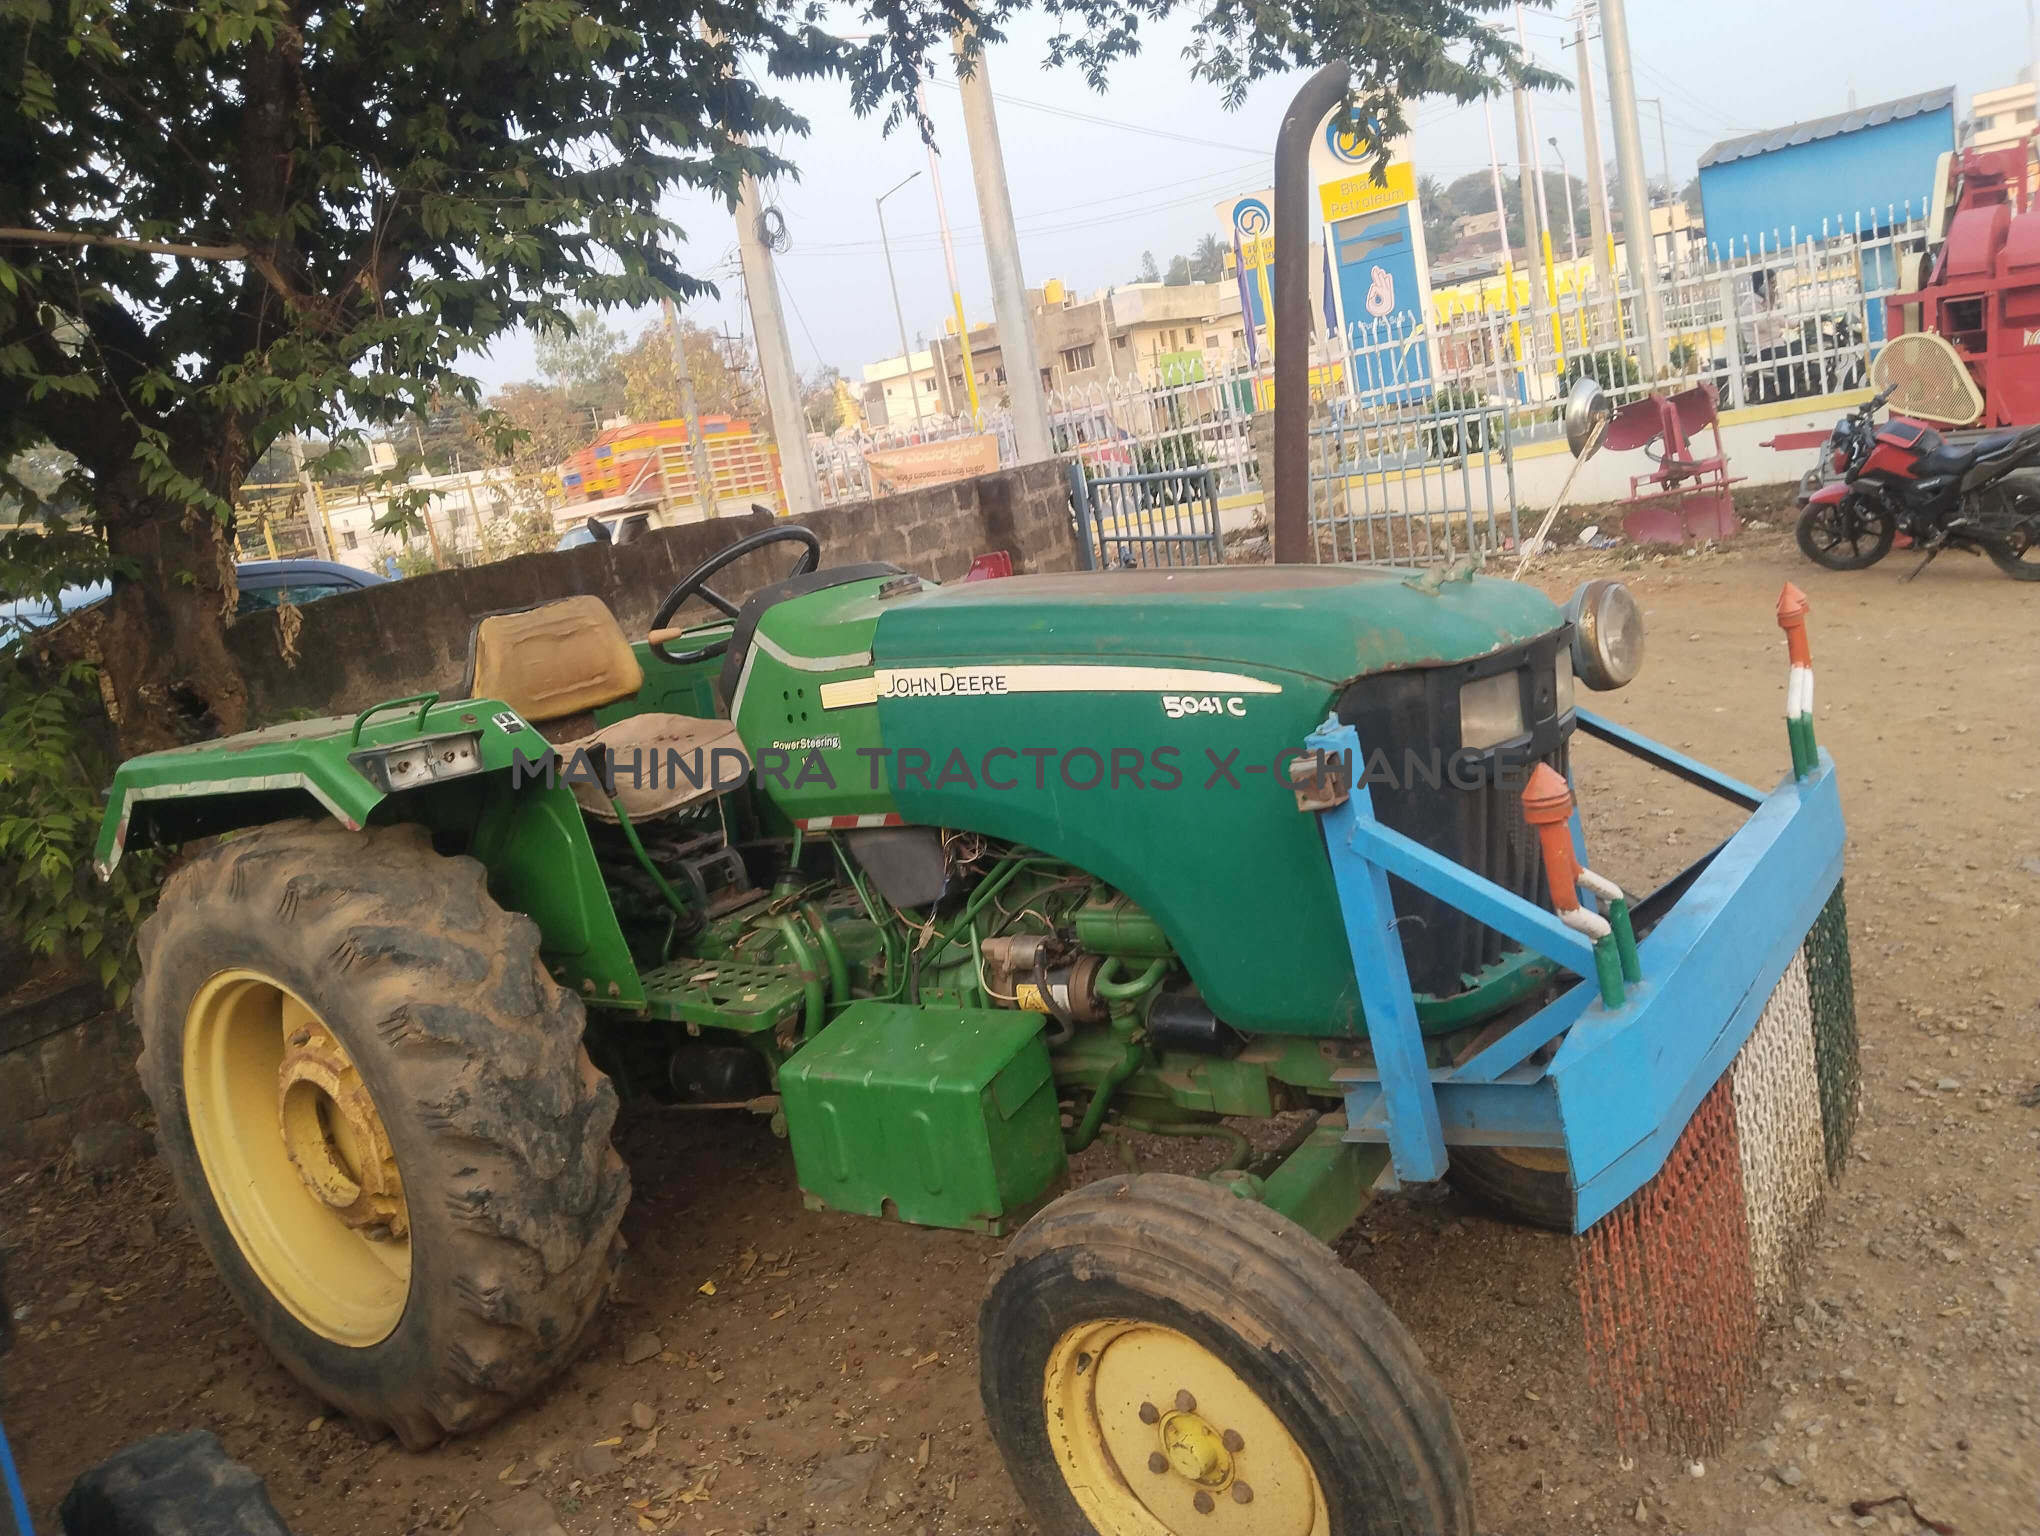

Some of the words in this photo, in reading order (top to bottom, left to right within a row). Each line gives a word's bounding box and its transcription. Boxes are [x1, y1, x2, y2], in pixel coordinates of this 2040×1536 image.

[1331, 188, 1404, 216] Petroleum
[884, 672, 937, 695] JOHN
[939, 671, 1008, 694] DEERE
[1162, 696, 1223, 719] 5041
[1226, 696, 1248, 718] C
